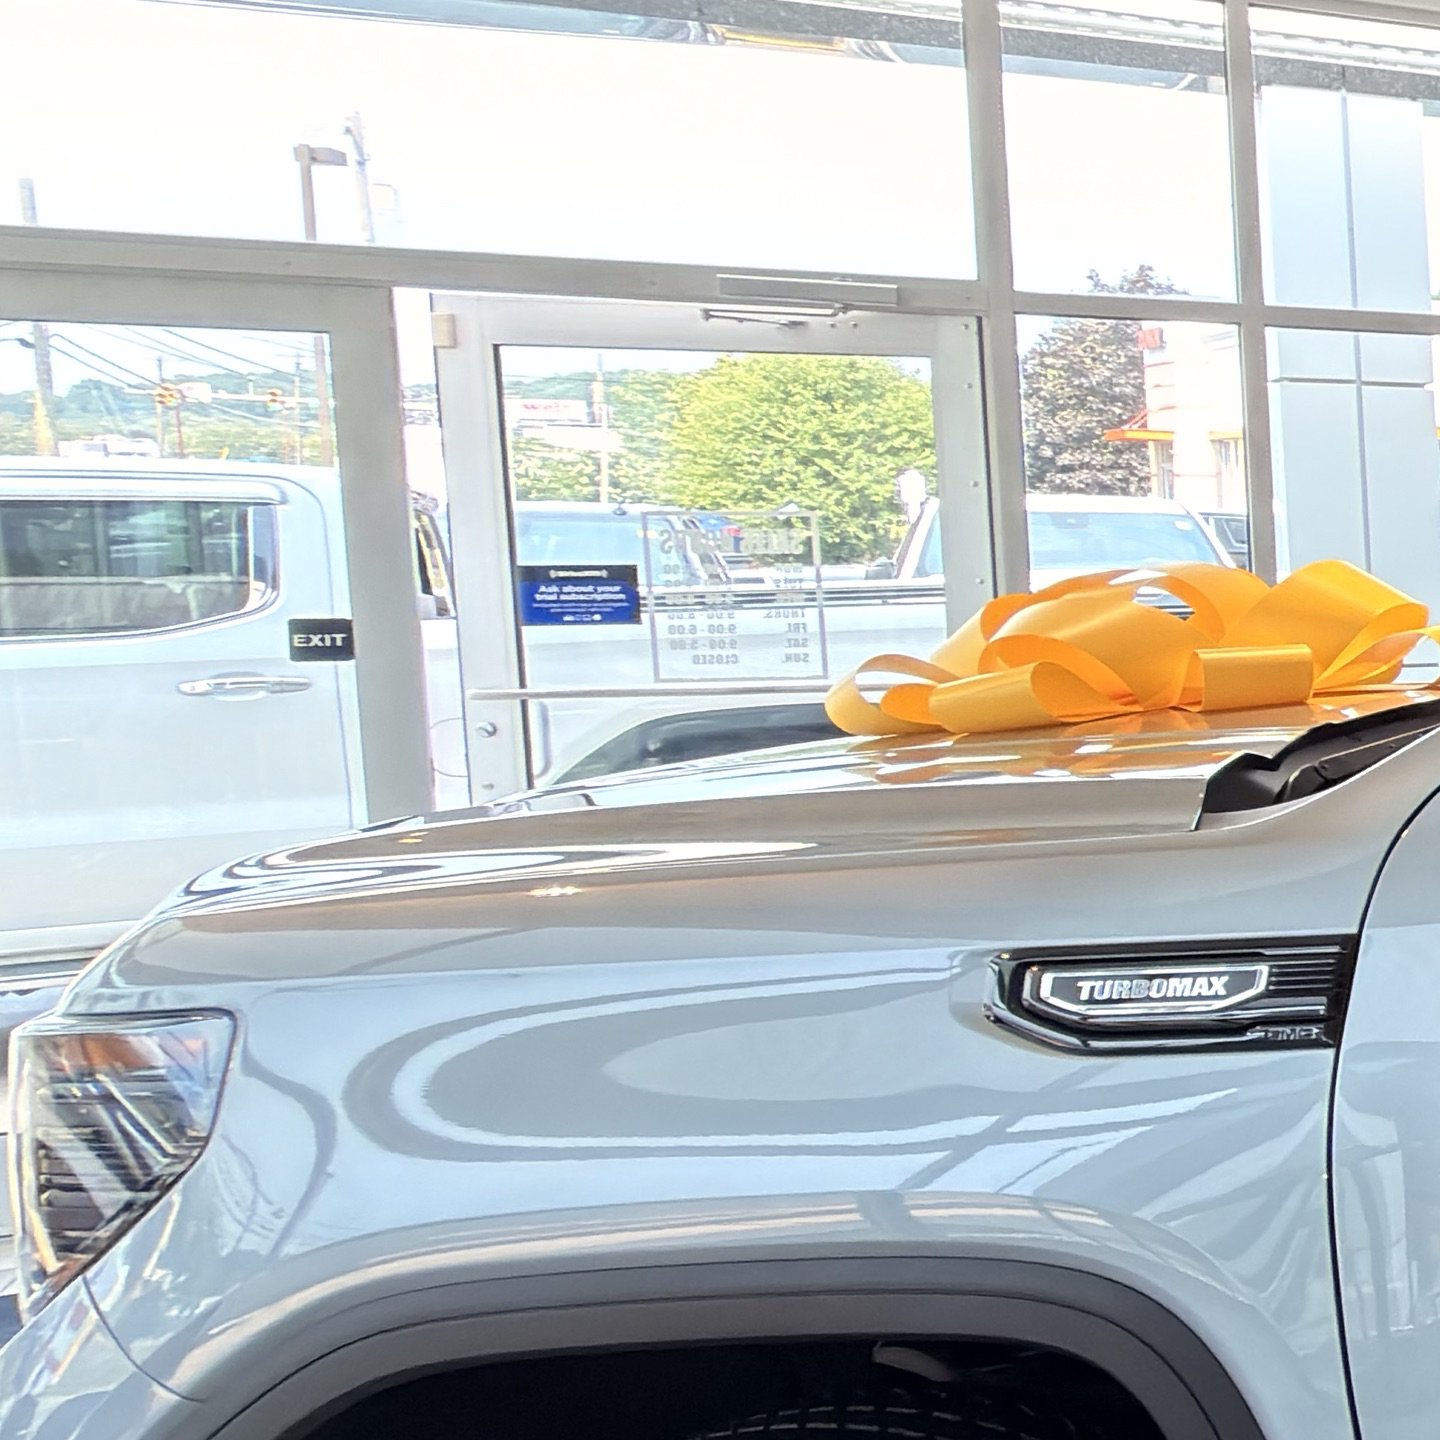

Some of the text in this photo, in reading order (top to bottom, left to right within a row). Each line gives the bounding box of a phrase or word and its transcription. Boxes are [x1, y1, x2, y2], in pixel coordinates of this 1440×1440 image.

[537, 585, 622, 594] Ask about your
[534, 593, 627, 602] trial subscription
[292, 633, 348, 647] EXIT
[1077, 975, 1229, 1001] TURBOMAX
